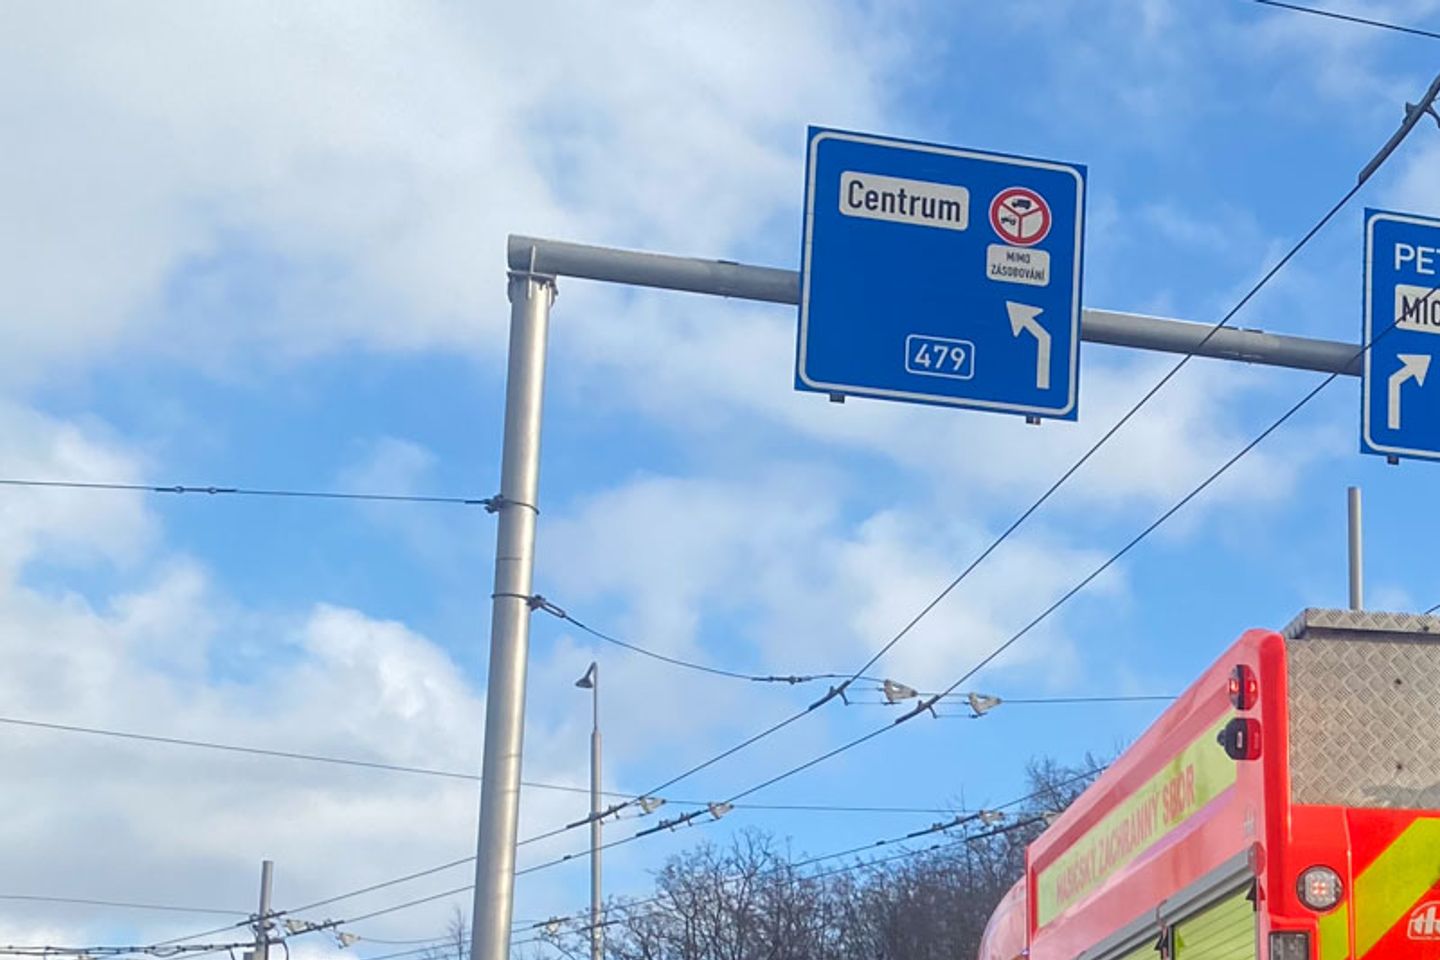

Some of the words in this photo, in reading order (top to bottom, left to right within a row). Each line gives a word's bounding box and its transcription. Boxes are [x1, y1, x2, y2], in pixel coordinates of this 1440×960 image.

[846, 179, 961, 222] Centrum
[1006, 252, 1030, 264] MIMO
[915, 343, 966, 371] 479
